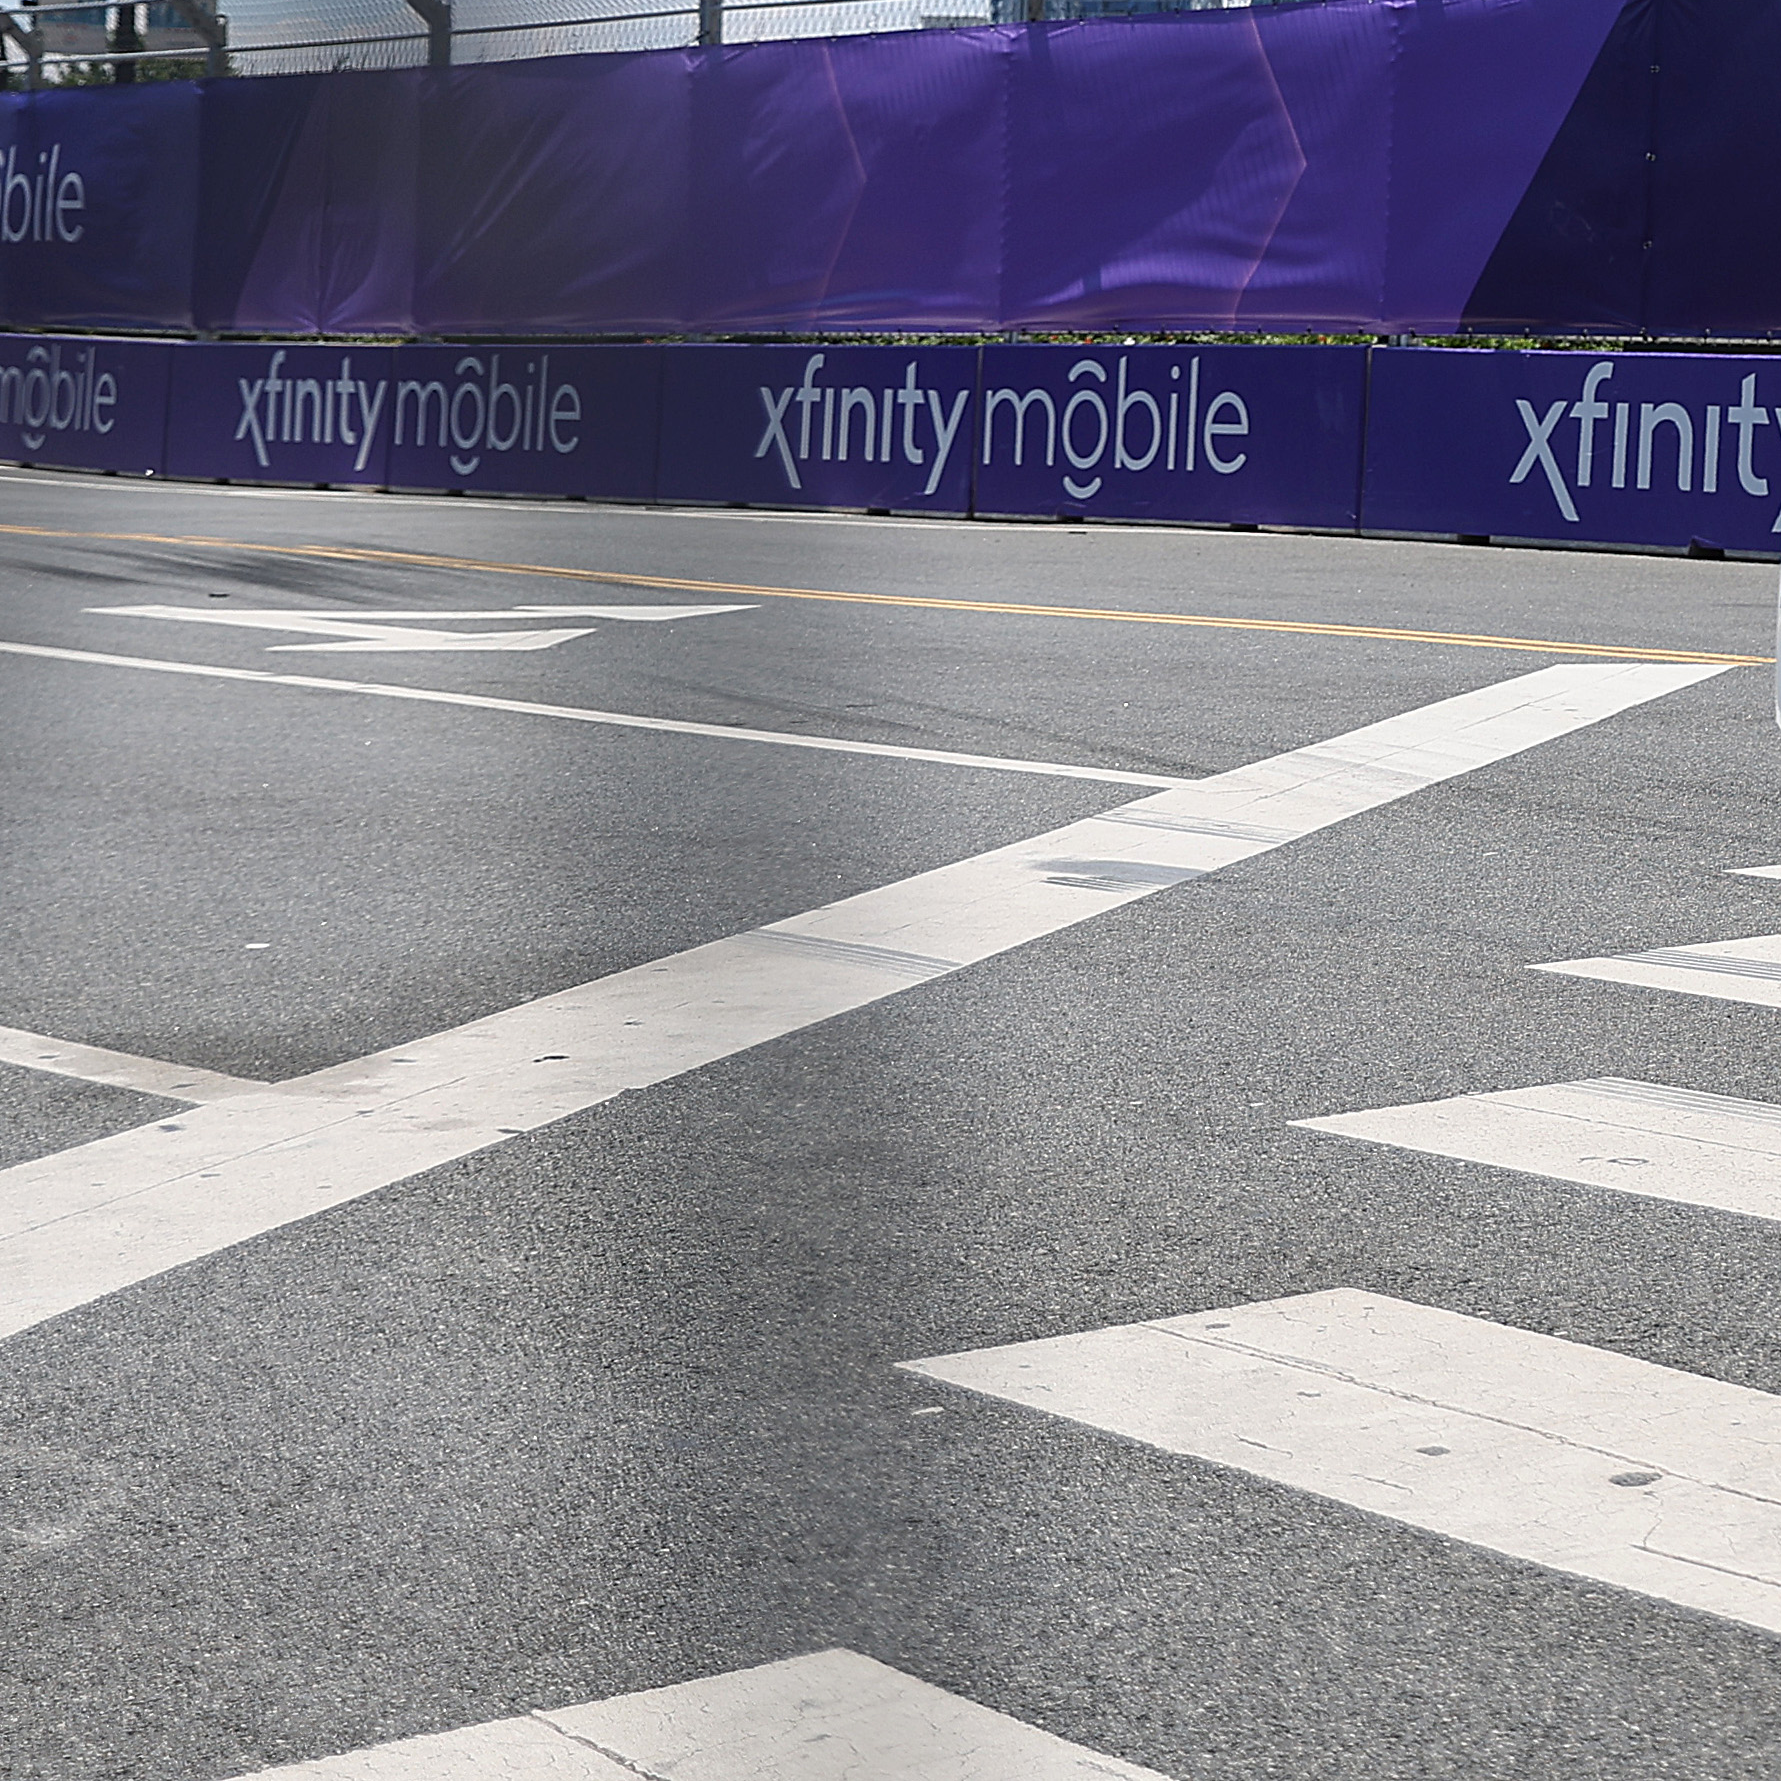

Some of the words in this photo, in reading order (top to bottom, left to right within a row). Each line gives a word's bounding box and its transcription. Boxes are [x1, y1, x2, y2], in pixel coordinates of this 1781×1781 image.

[0, 143, 85, 243] bile
[235, 349, 388, 472] xfinity
[394, 354, 582, 476] mobile
[754, 353, 970, 496] xfinity
[982, 355, 1249, 500] mobile
